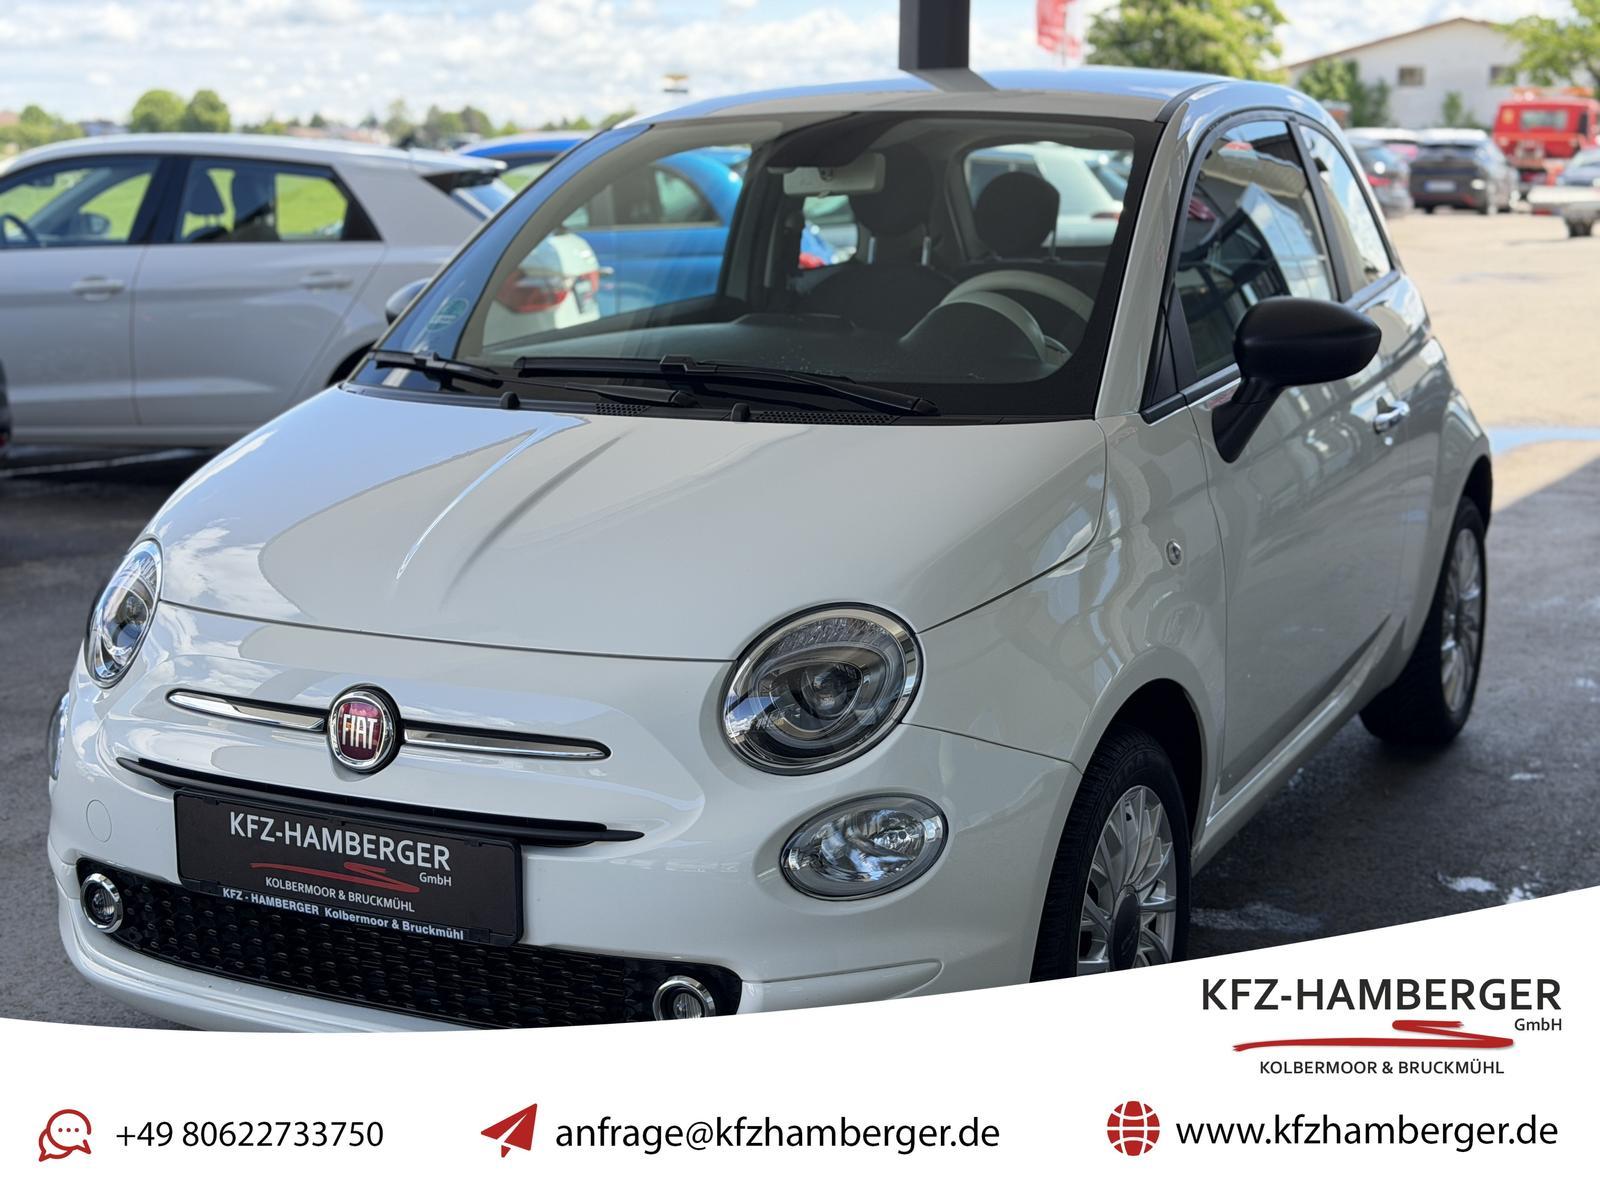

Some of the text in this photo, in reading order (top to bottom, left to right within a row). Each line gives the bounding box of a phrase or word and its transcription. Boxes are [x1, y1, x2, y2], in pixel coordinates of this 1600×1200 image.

[342, 713, 379, 749] FIAT
[230, 811, 451, 871] KFZ-HAMBERGER
[265, 876, 415, 913] KOLBERMOOR & BRUCKMÜHL
[419, 872, 452, 887] GmbH
[222, 887, 243, 900] KFZ
[251, 893, 319, 915] HAMBERGER
[324, 907, 389, 928] Kolbermoor
[391, 919, 400, 929] &
[402, 921, 464, 940] Bruckmühl
